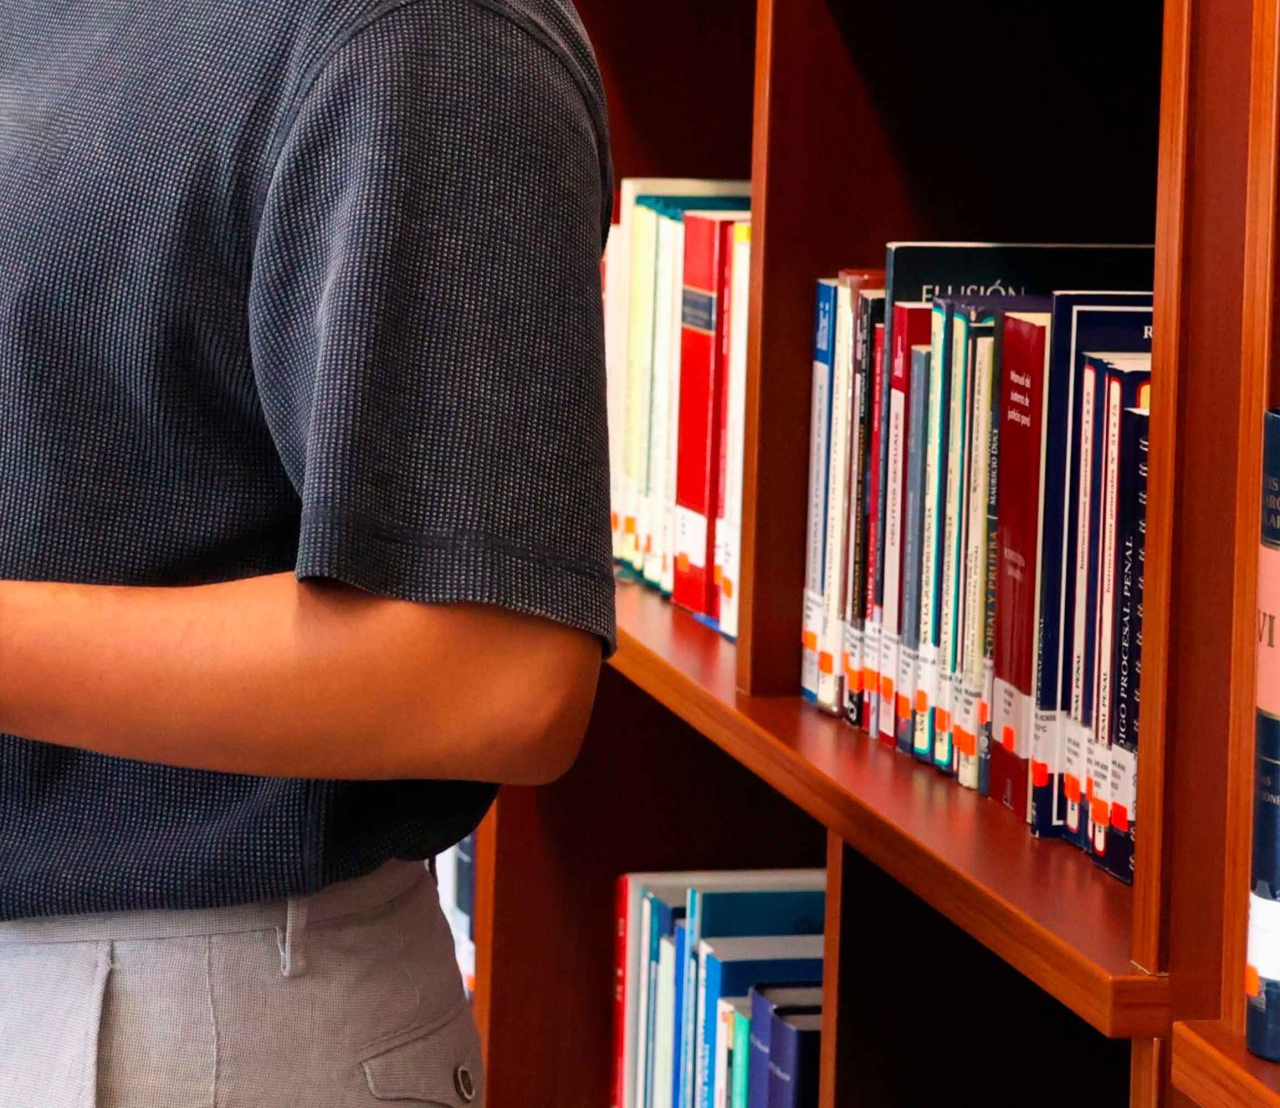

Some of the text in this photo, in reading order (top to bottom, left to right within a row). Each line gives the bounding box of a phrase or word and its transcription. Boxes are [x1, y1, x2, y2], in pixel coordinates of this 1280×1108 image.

[991, 428, 999, 454] DUCE
[990, 457, 998, 505] MAURICIO
[1123, 536, 1133, 597] PENAL
[1120, 602, 1131, 698] PROCESAL
